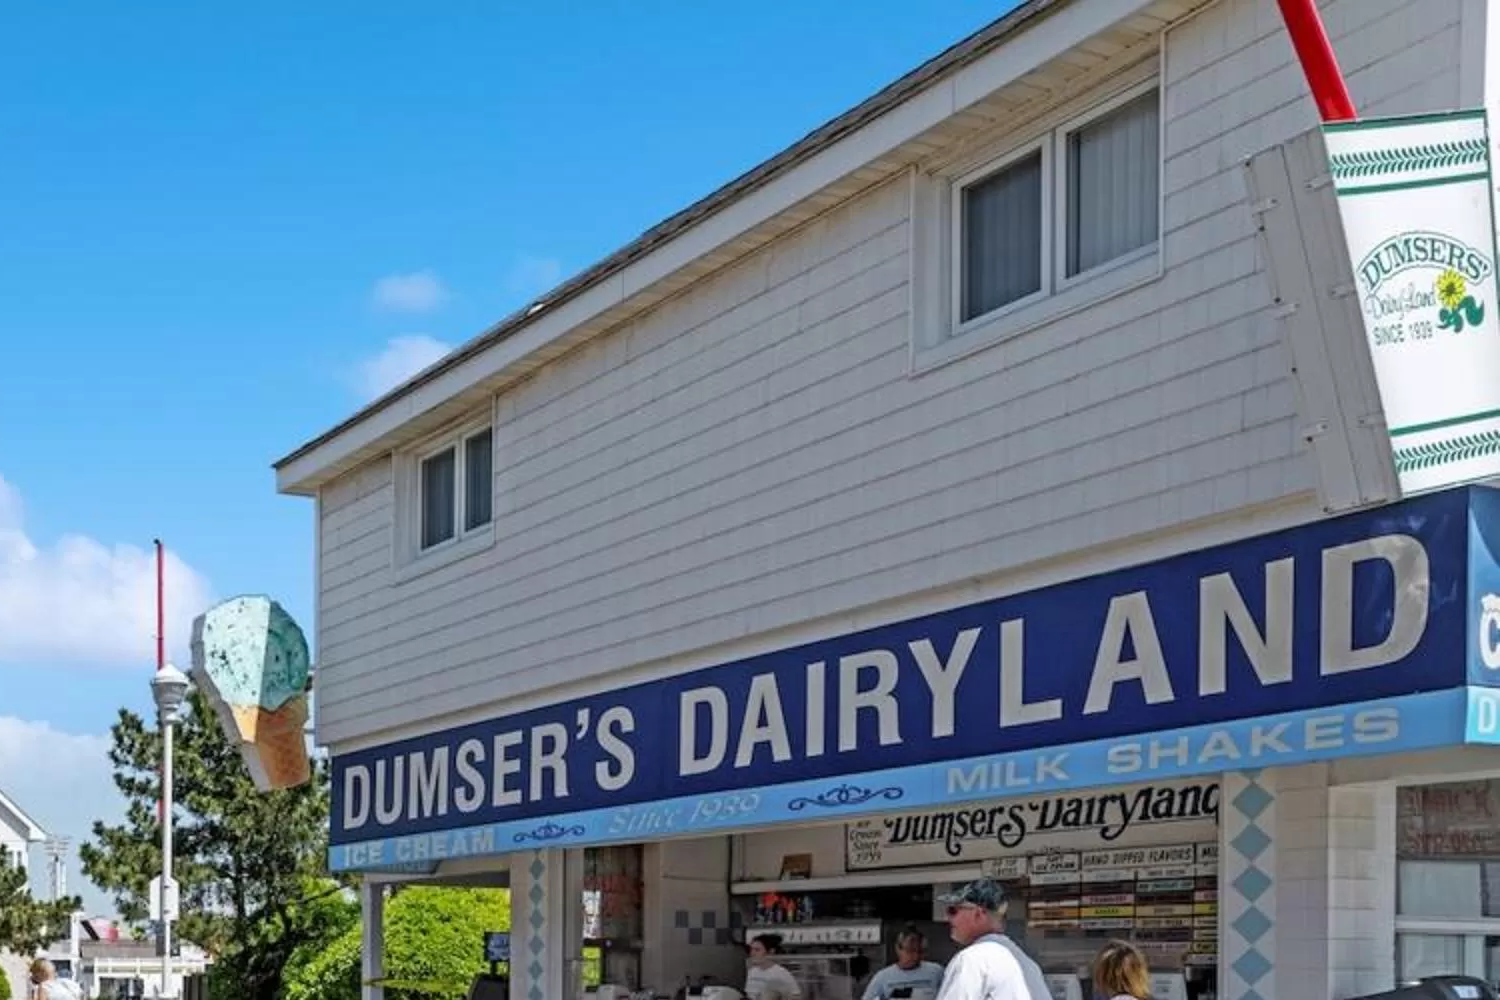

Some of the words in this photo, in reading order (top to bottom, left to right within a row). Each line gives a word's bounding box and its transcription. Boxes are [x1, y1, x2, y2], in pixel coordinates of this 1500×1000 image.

[1373, 323, 1404, 346] SINCE
[343, 704, 635, 831] DUMSER'S
[679, 533, 1430, 777] DAIRYLAND
[946, 752, 1072, 796] MILK
[1106, 706, 1400, 775] SHAKES
[344, 841, 383, 867] ICE
[395, 827, 495, 861] CREAM
